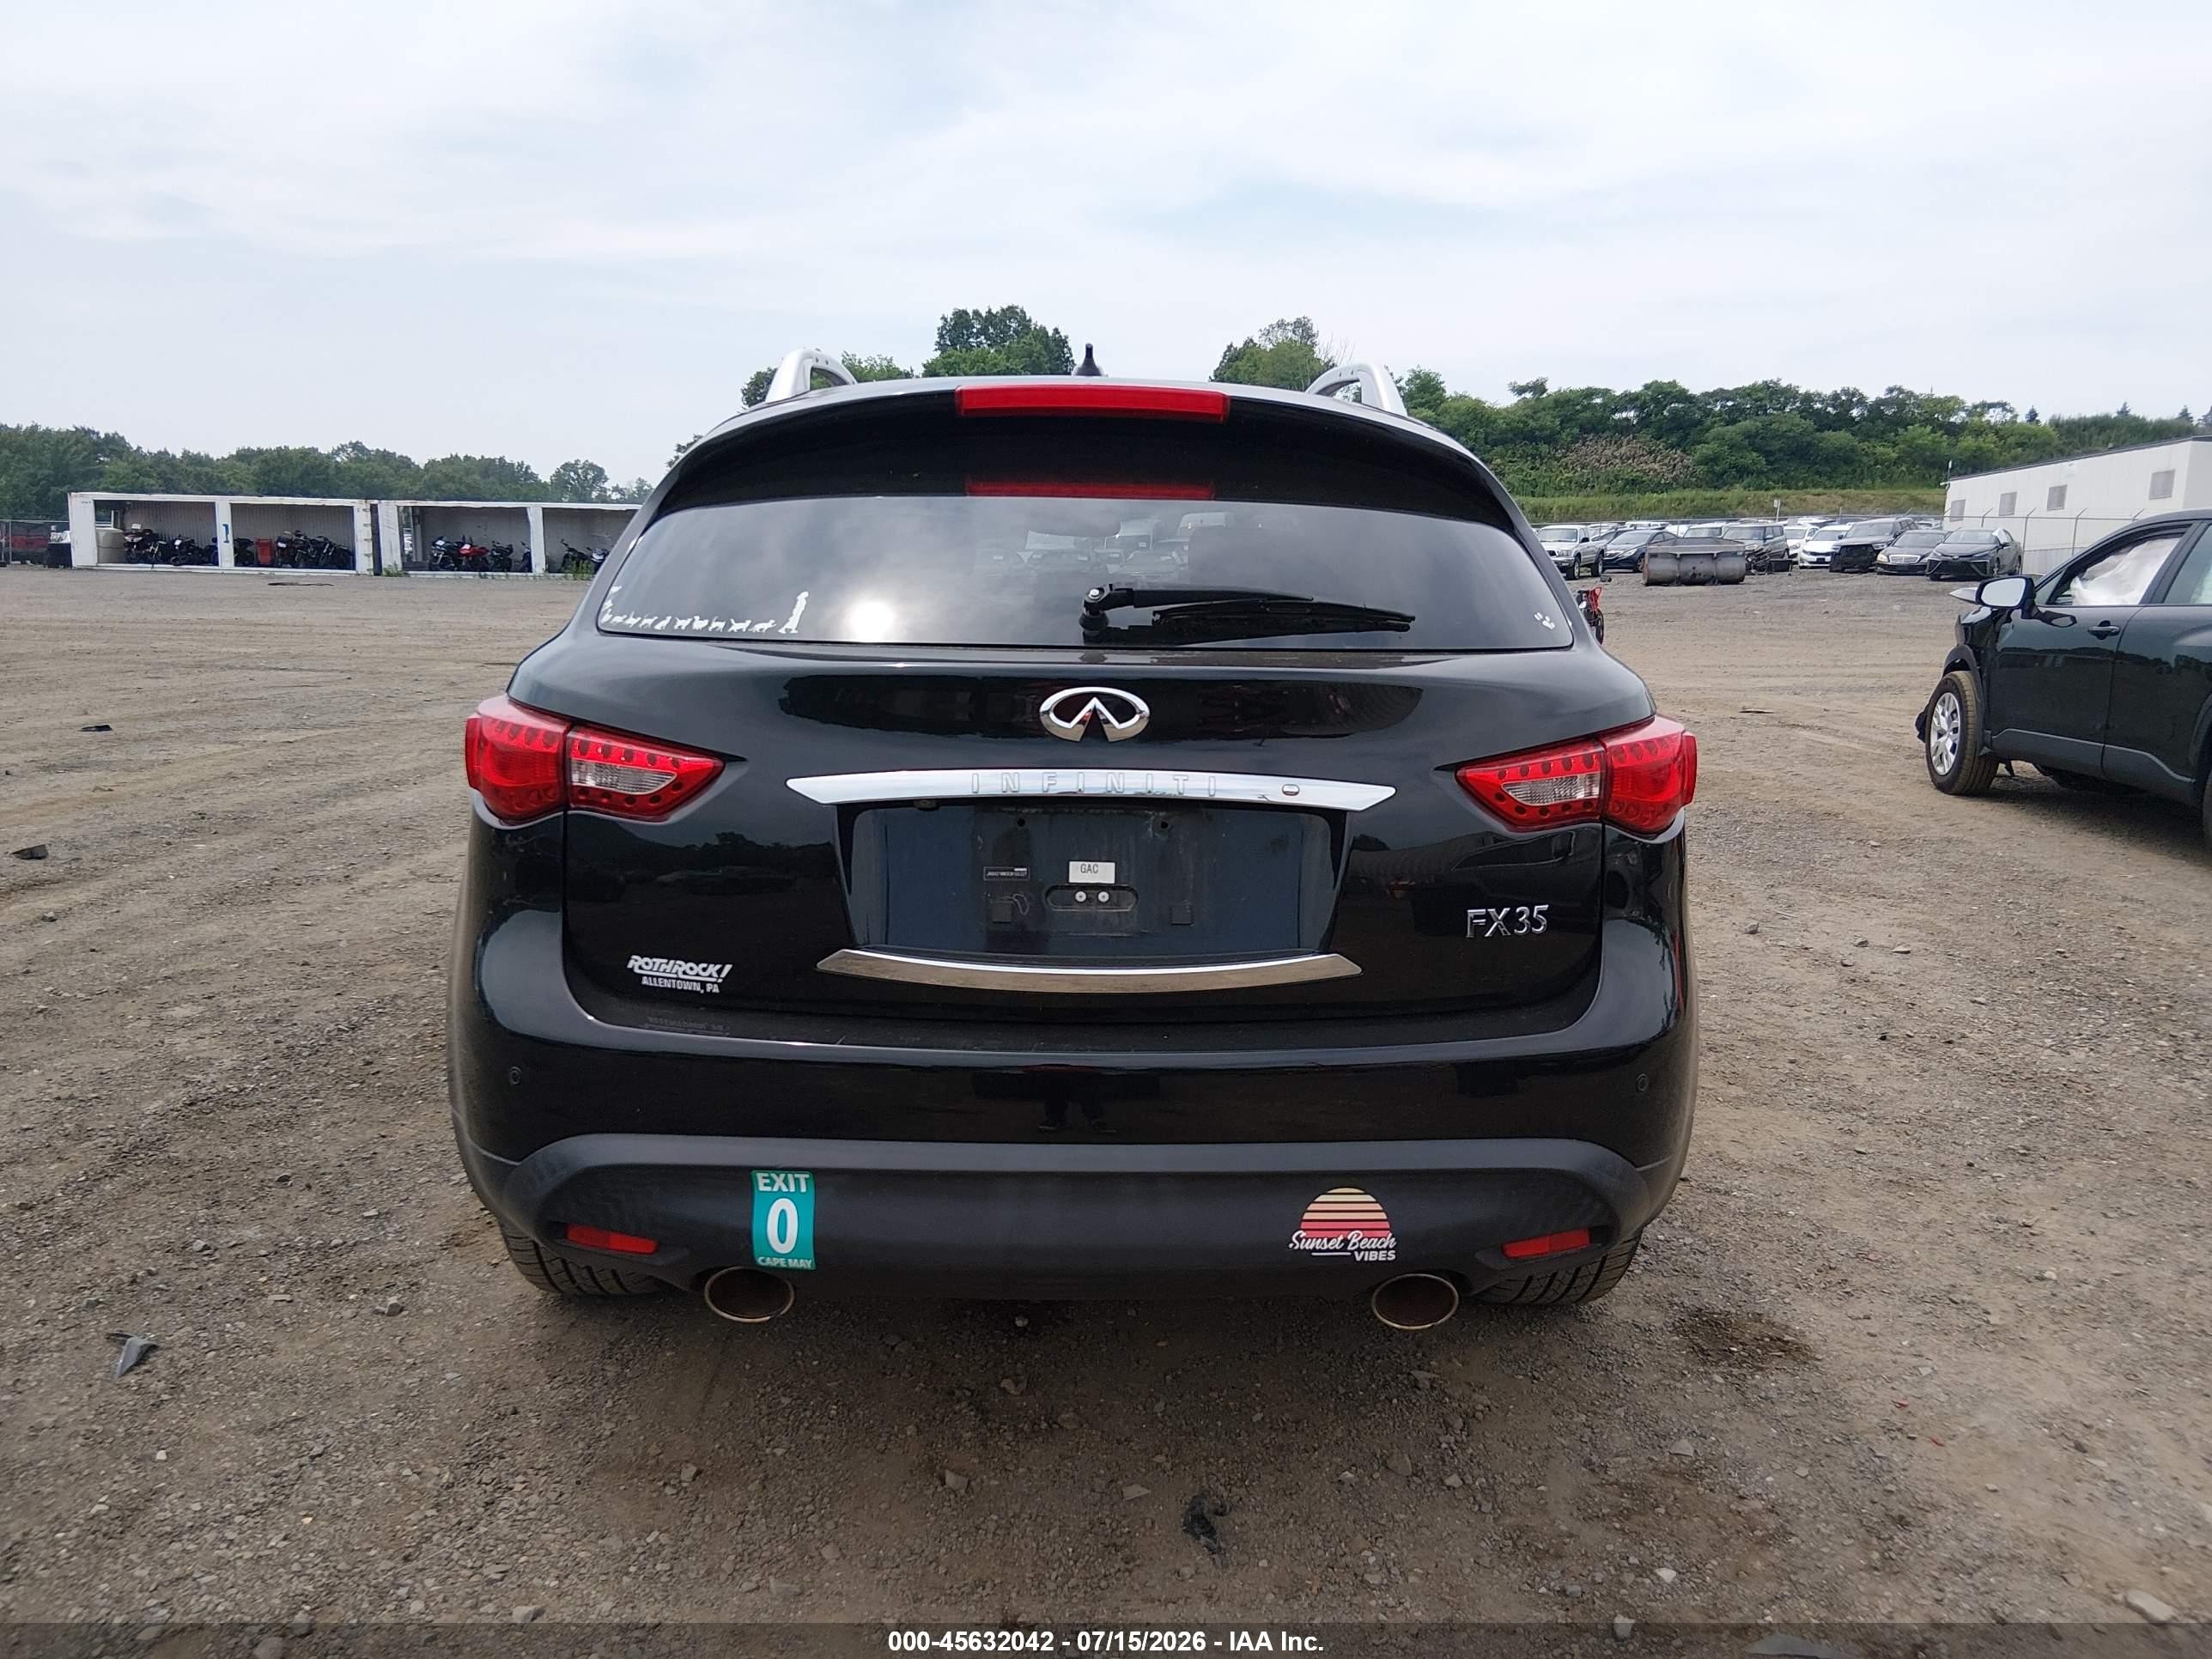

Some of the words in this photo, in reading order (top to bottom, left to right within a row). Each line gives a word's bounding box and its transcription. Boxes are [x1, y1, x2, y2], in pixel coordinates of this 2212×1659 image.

[971, 772, 1217, 797] INFINITI
[1080, 863, 1099, 874] GAC
[1466, 904, 1550, 938] FX35
[627, 955, 733, 983] ROTHROCK!
[641, 975, 705, 994] ALLENTOWN,
[705, 982, 720, 994] PA
[757, 1172, 810, 1193] EXIT
[766, 1198, 799, 1255] 0
[1288, 1231, 1344, 1250] Sunset
[1346, 1231, 1397, 1250] Beach
[757, 1256, 787, 1267] CAPE
[787, 1259, 812, 1269] MAY
[1353, 1250, 1396, 1261] VIBES
